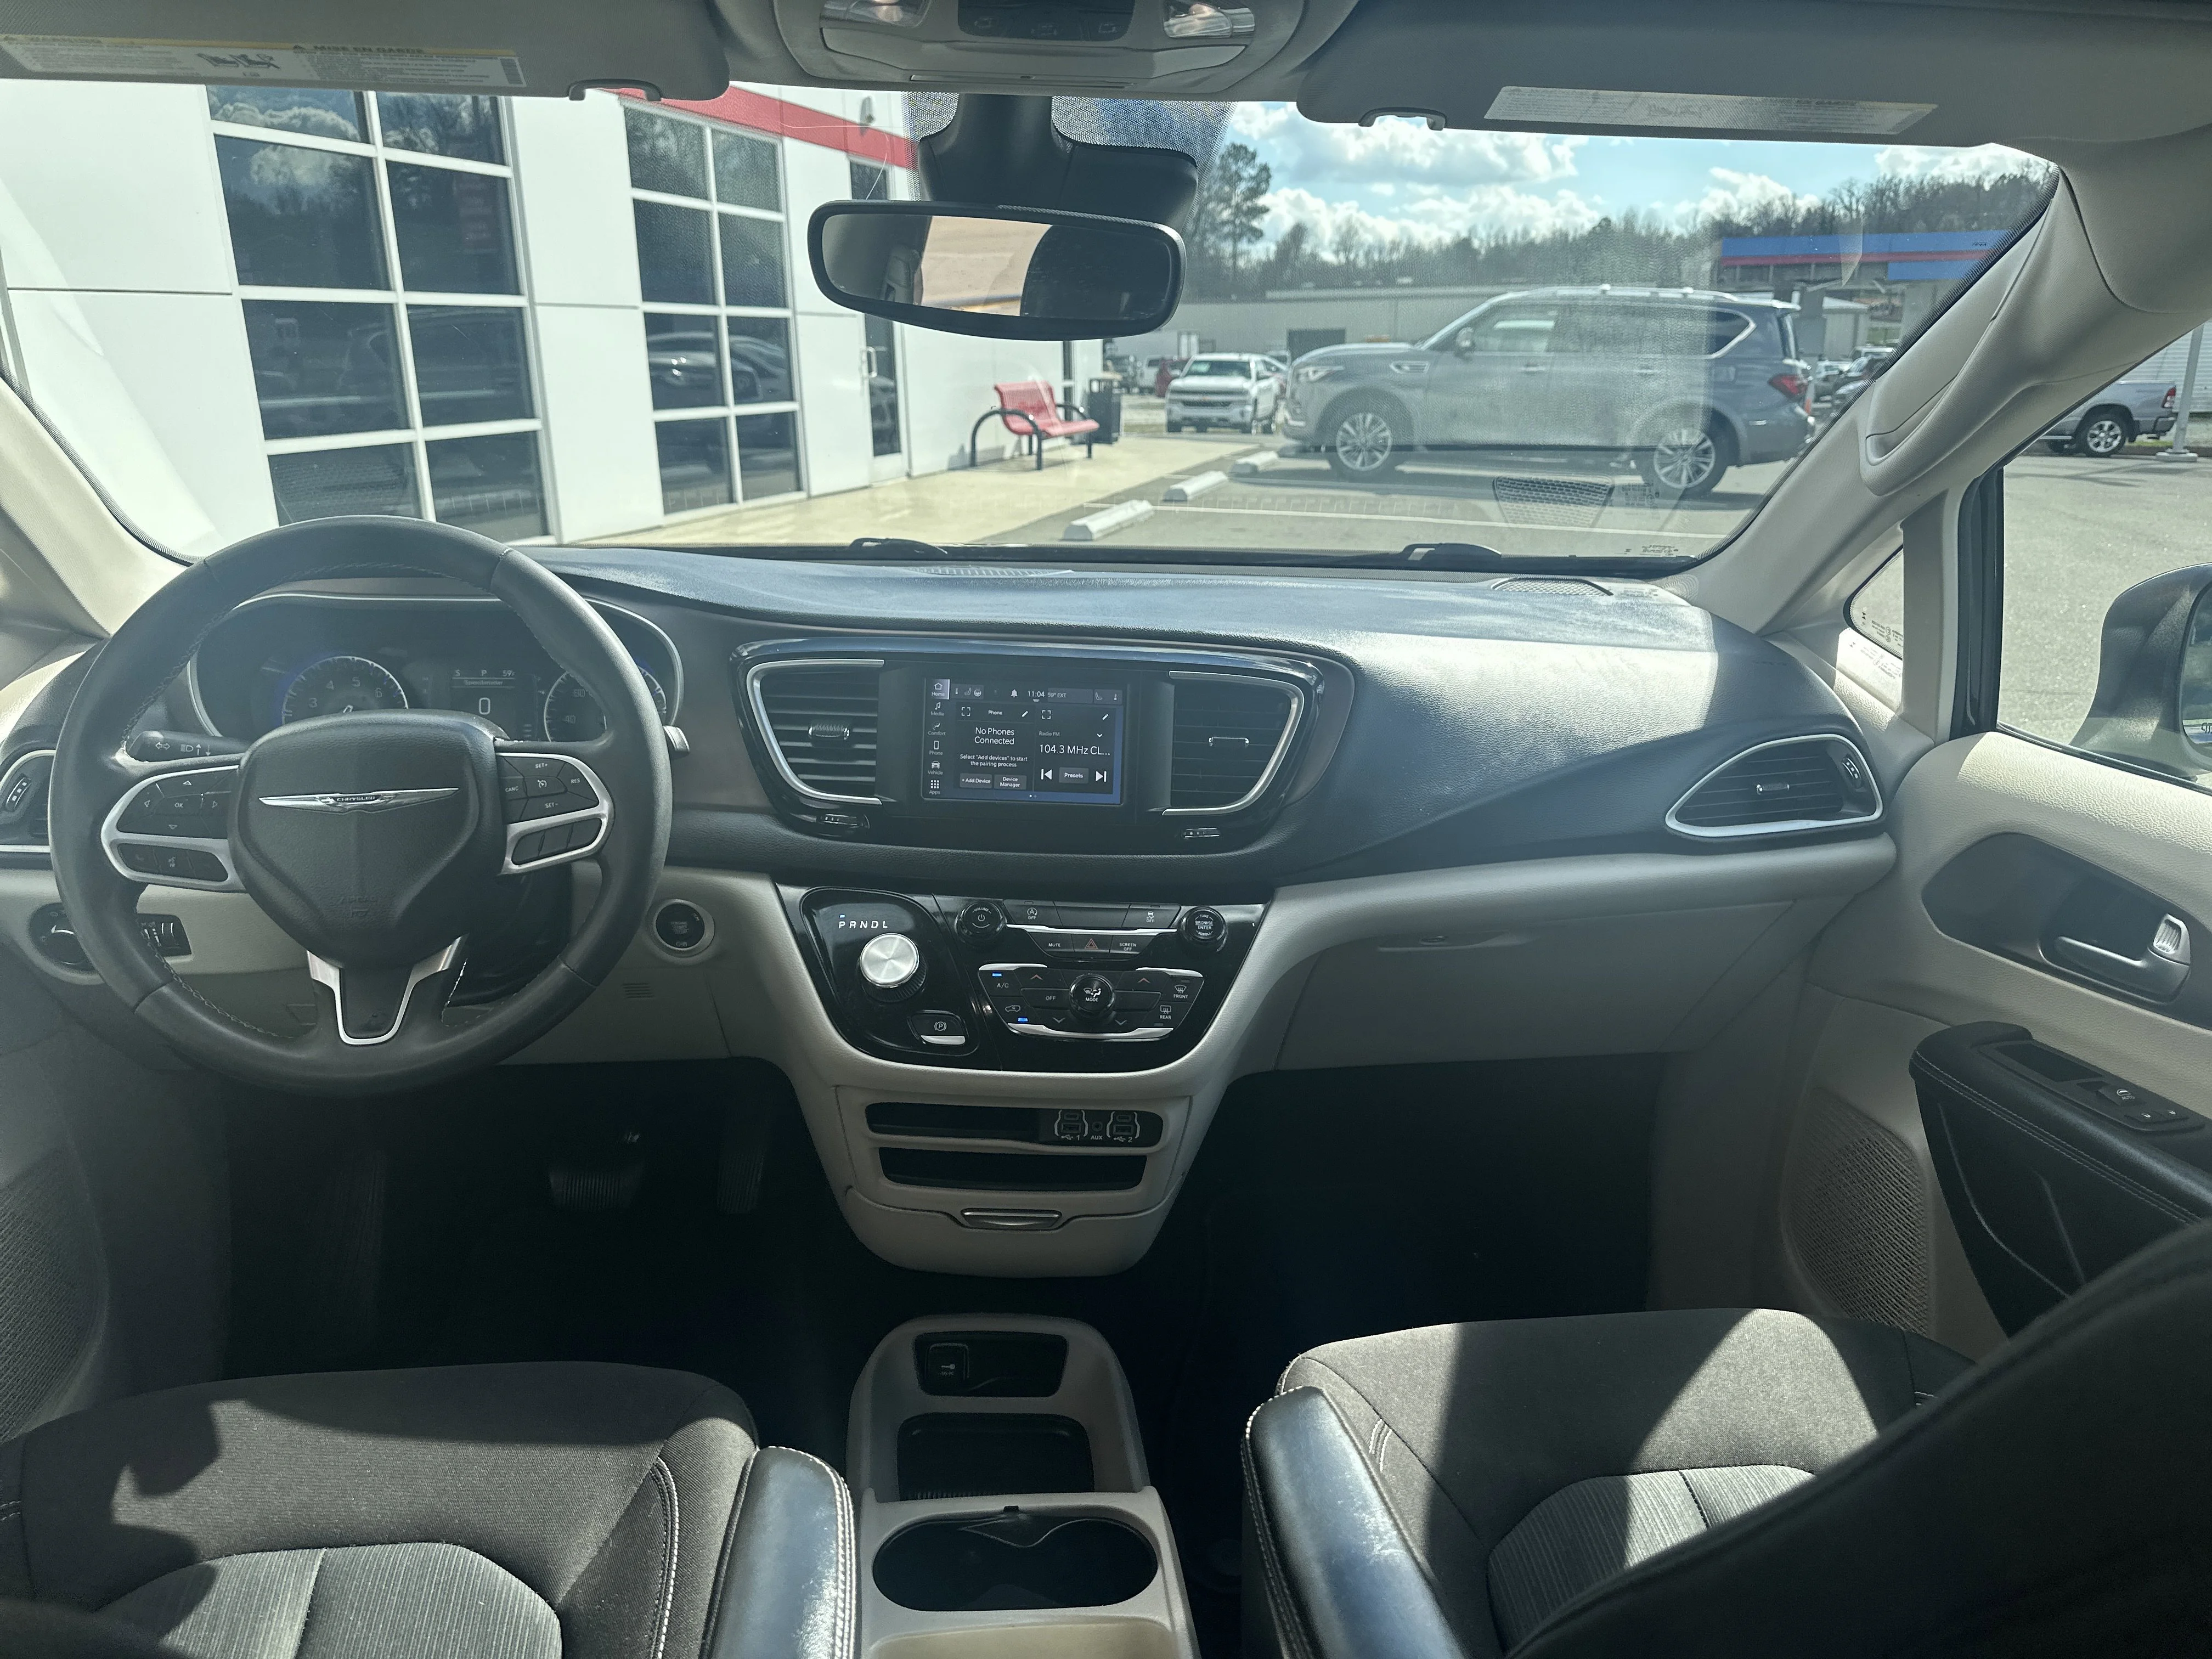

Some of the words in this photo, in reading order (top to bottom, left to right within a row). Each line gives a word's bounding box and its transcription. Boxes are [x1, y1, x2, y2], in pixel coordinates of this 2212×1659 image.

[326, 680, 335, 690] 4
[352, 677, 360, 687] 5
[376, 687, 382, 698] 6
[309, 697, 318, 708] 3
[478, 697, 491, 715] 0
[988, 727, 1015, 736] Phones
[974, 736, 1014, 745] Connected
[1040, 744, 1065, 754] 104.3
[1067, 745, 1088, 755] MHz
